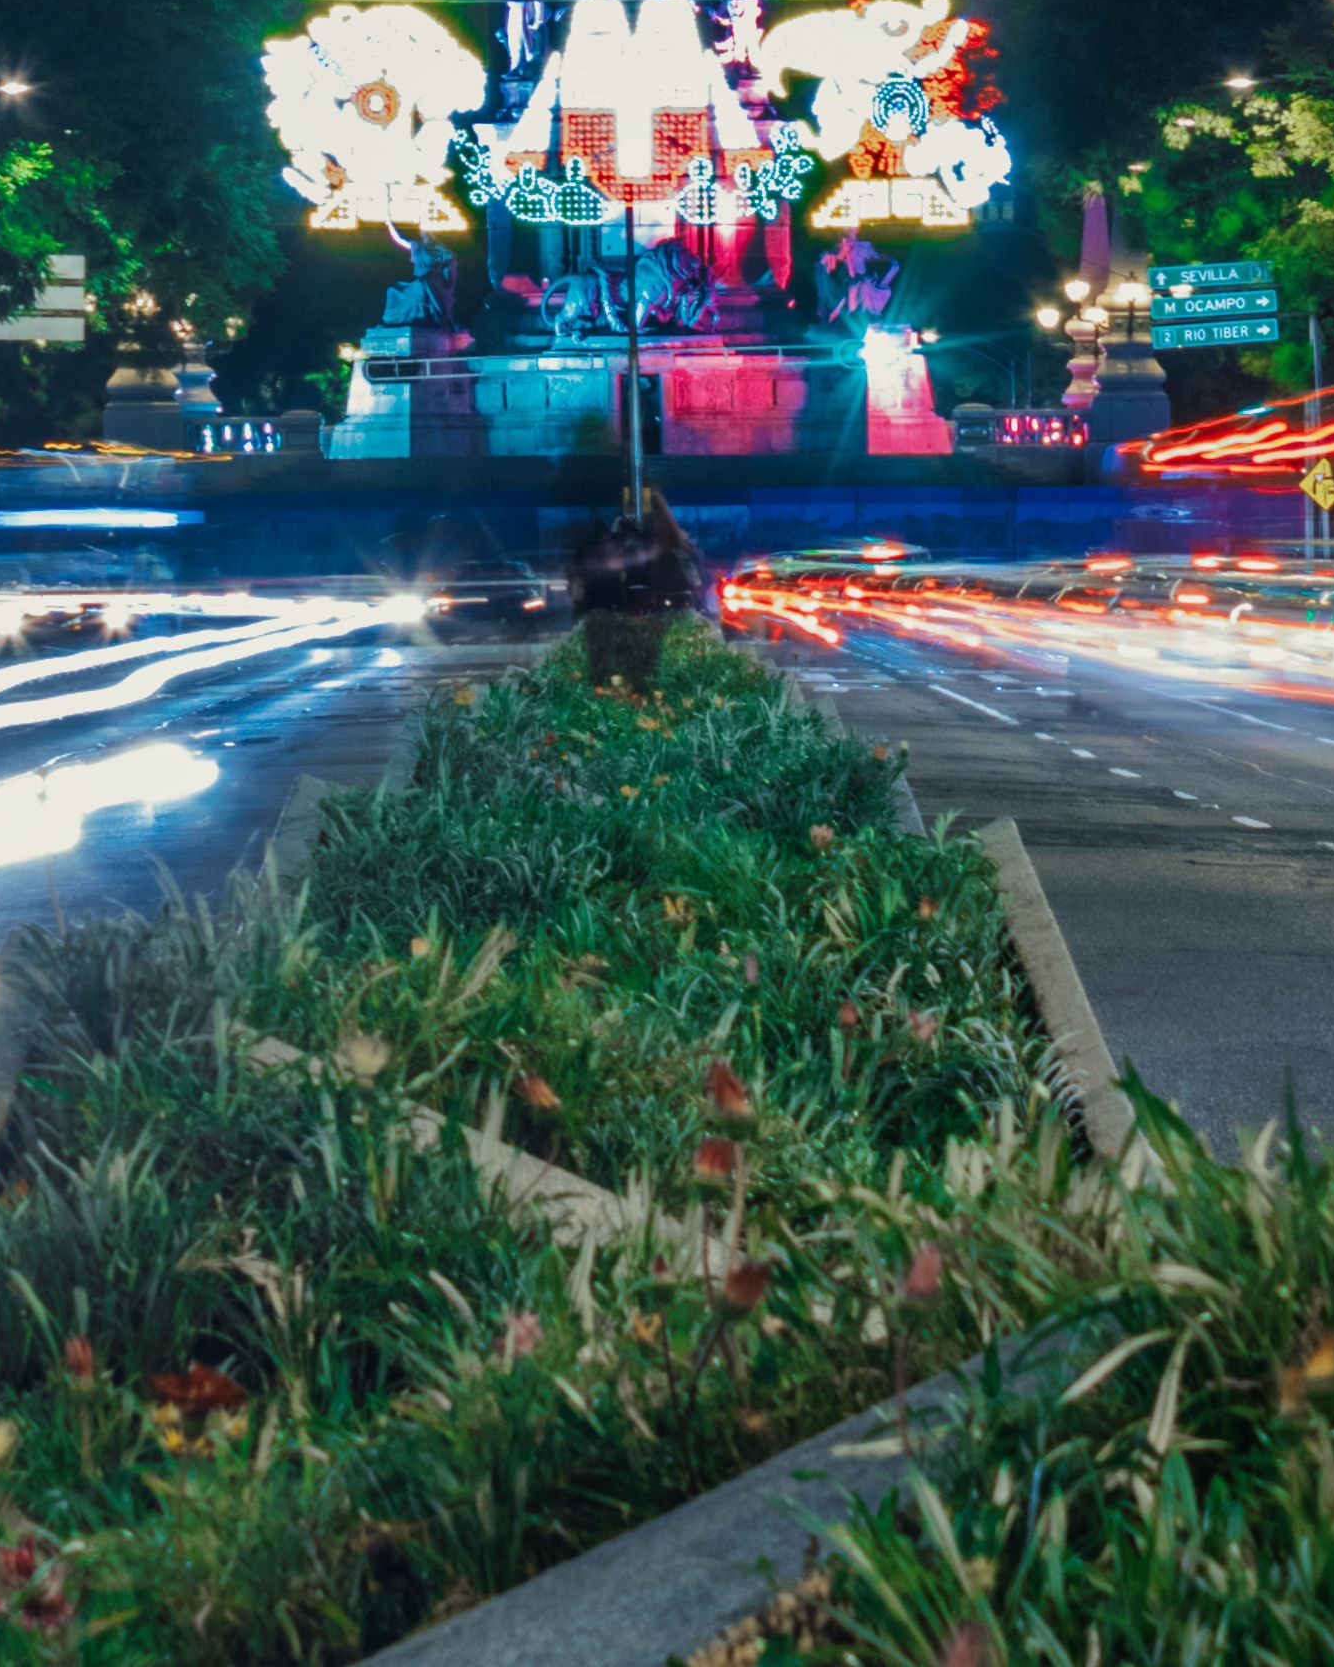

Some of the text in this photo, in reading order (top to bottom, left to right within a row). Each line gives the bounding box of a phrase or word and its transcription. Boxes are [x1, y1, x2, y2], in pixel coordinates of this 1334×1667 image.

[1180, 268, 1239, 283] SEVILLA
[1164, 297, 1246, 313] M OCAMPO
[1184, 328, 1206, 342] RIO
[1212, 325, 1249, 339] TIBER
